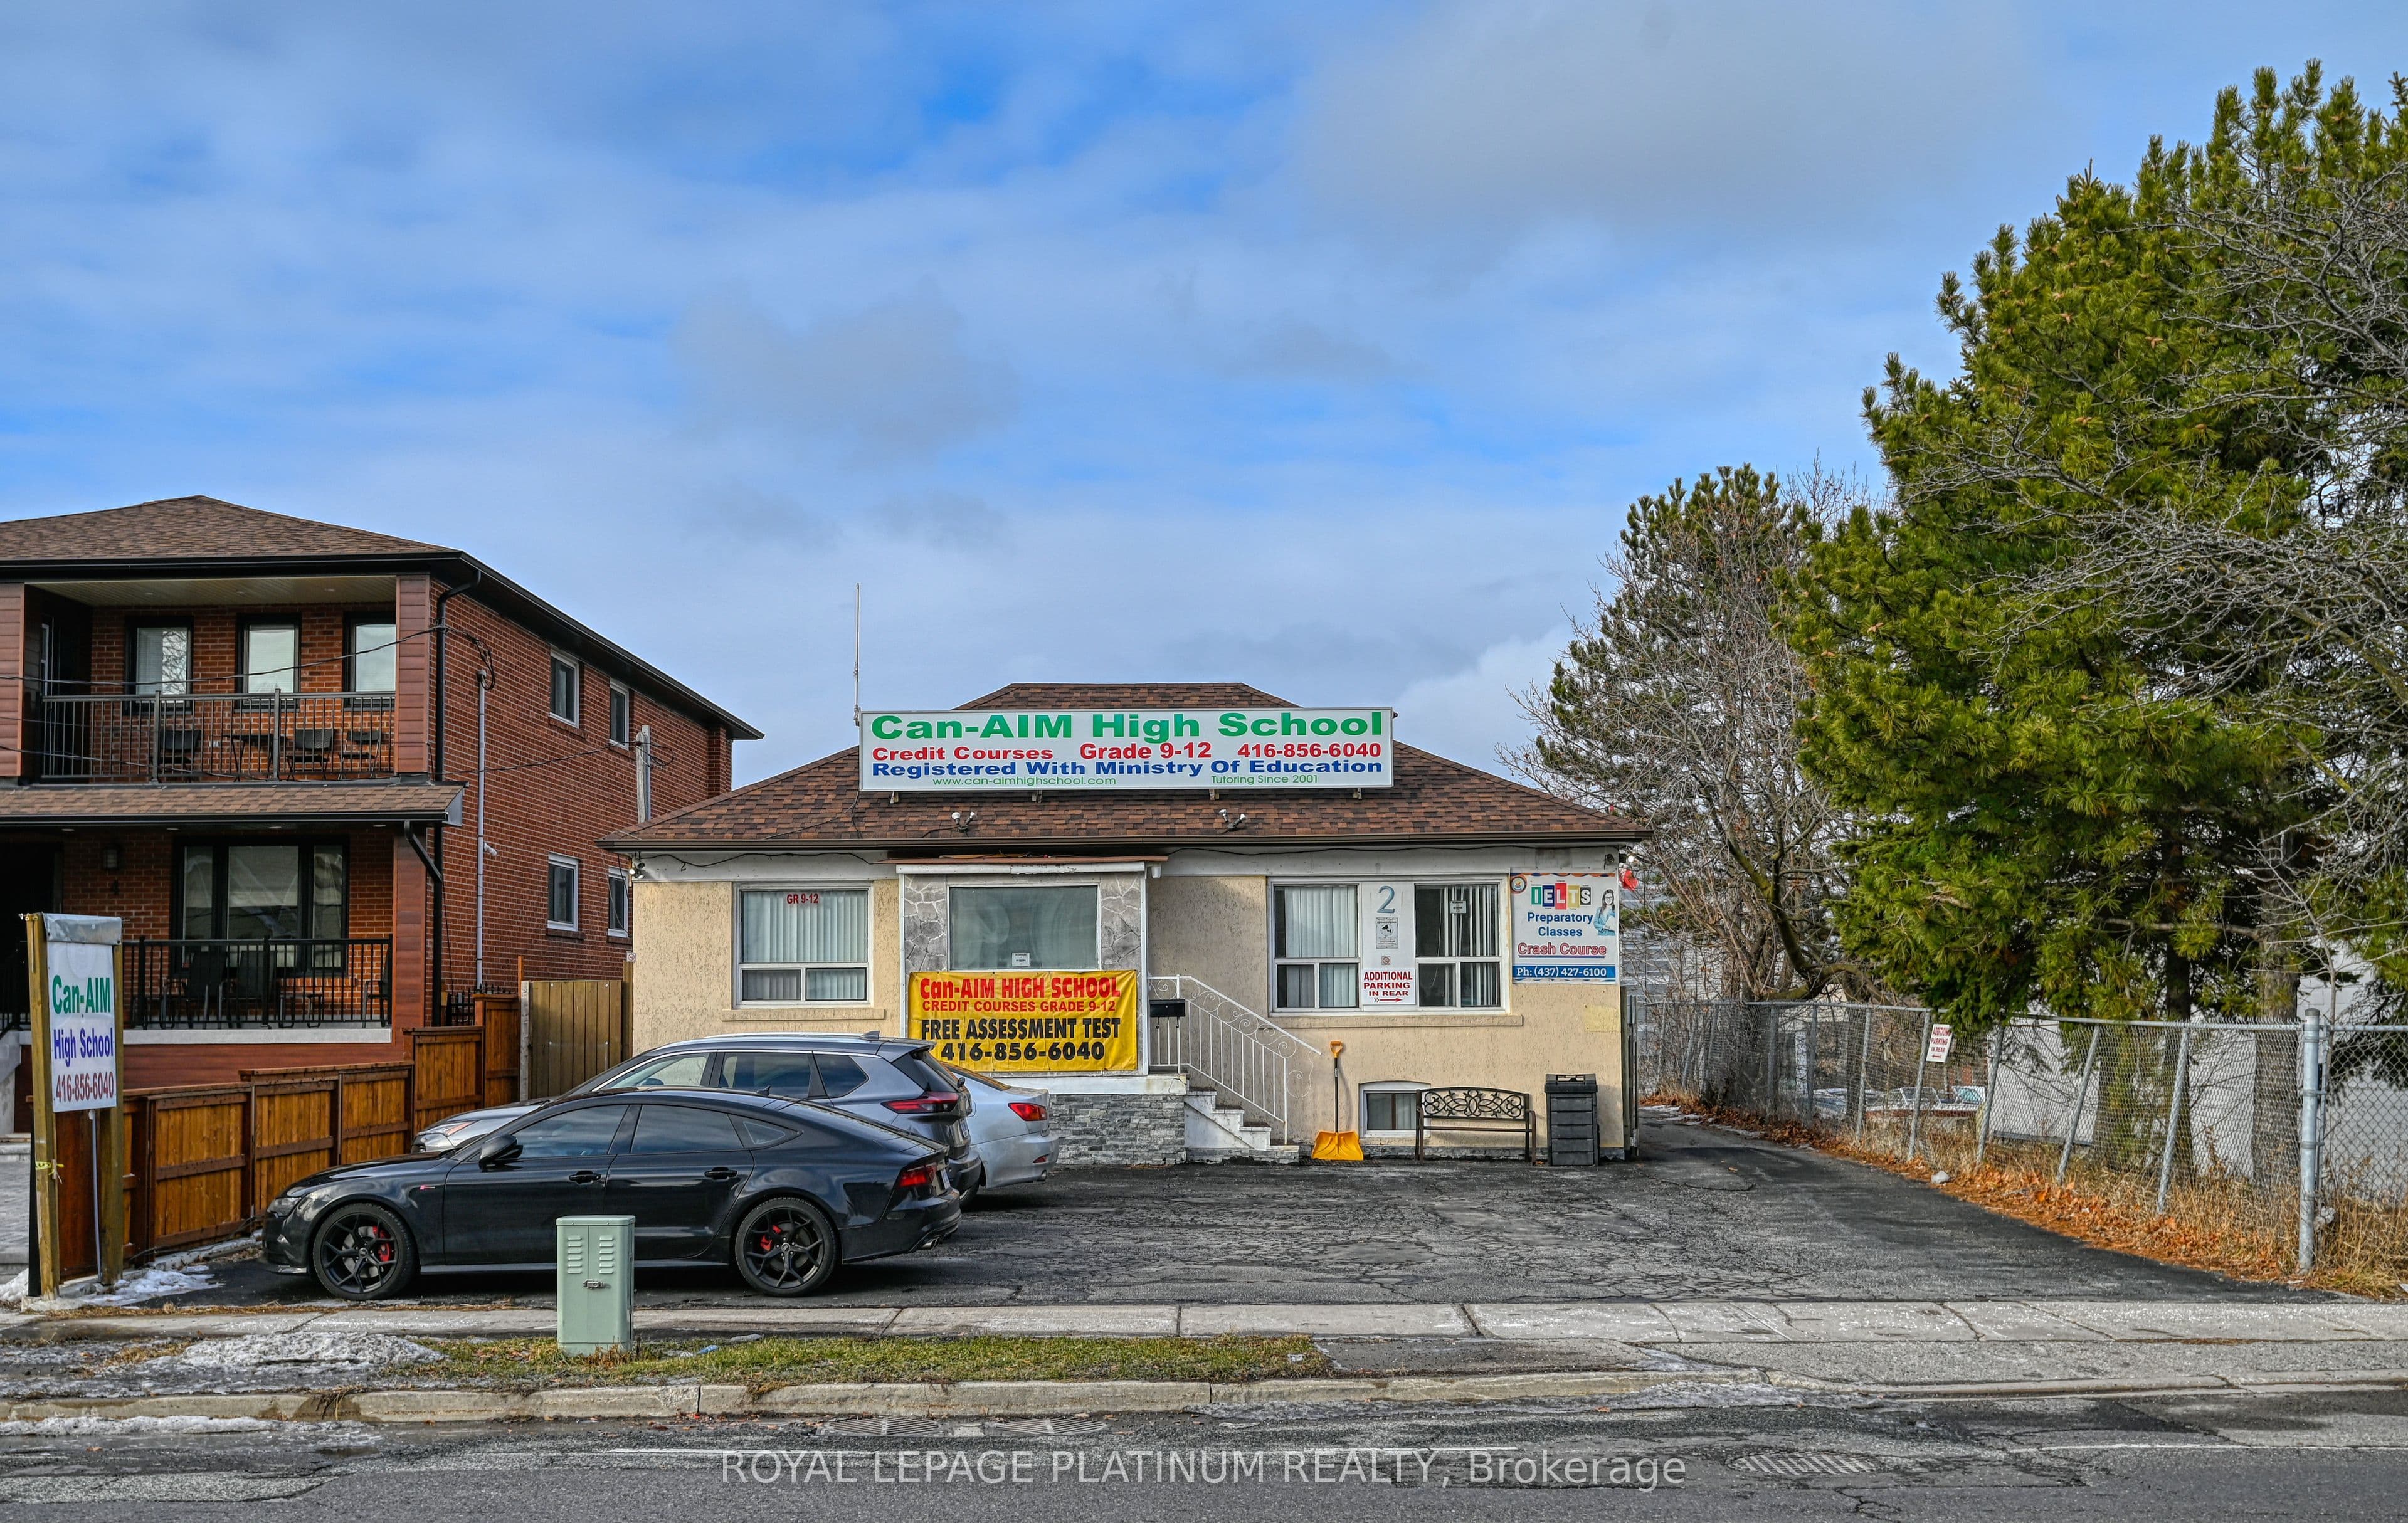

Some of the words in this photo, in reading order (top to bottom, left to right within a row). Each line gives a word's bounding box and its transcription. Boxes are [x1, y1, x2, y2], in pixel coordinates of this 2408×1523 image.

[871, 714, 1072, 740] Can-AIM
[1092, 714, 1200, 744] High
[1218, 712, 1382, 737] School
[872, 747, 945, 761] Credit
[954, 746, 1054, 761] Courses
[1080, 743, 1151, 759] Grade
[1159, 742, 1212, 759] 9-12
[1237, 742, 1381, 758] 416-856-6040
[872, 762, 1016, 779] Registered
[1025, 761, 1085, 775] With
[1096, 760, 1203, 777] Ministry
[1210, 760, 1241, 774] Of
[1249, 759, 1382, 773] Education
[932, 776, 1116, 786] www.can-aimhighschool.com
[1212, 775, 1255, 785] Tutoring
[1257, 774, 1289, 783] Since
[1292, 774, 1318, 783] 2001
[787, 894, 798, 904] GR
[801, 893, 818, 904] 9-12
[1377, 885, 1395, 914] 2
[1533, 888, 1591, 905] IELTS
[1528, 912, 1593, 924] Preparatory
[1538, 927, 1582, 937] Classes
[1518, 942, 1556, 954] Crash
[1560, 942, 1607, 955] Course
[1364, 971, 1413, 981] ADDITIONAL
[1516, 967, 1533, 976] Ph:
[1534, 966, 1559, 977] (437)
[1561, 967, 1607, 976] 427-6100
[52, 975, 111, 1014] Can-AIM
[920, 977, 995, 999] Can-AIM
[1002, 977, 1045, 999] HIGH
[1051, 976, 1121, 998] SCHOOL
[922, 1001, 970, 1012] CREDIT
[974, 1001, 1036, 1013] COURSES
[1040, 1001, 1084, 1013] GRADE
[1089, 1000, 1116, 1012] 9-12
[921, 1019, 960, 1040] FREE
[966, 1018, 1078, 1040] ASSESSMENT
[1082, 1017, 1121, 1039] TEST
[53, 1028, 77, 1067] High
[80, 1028, 114, 1059] School
[941, 1041, 1105, 1061] 416-856-6040
[56, 1071, 114, 1103] 416-856-6040
